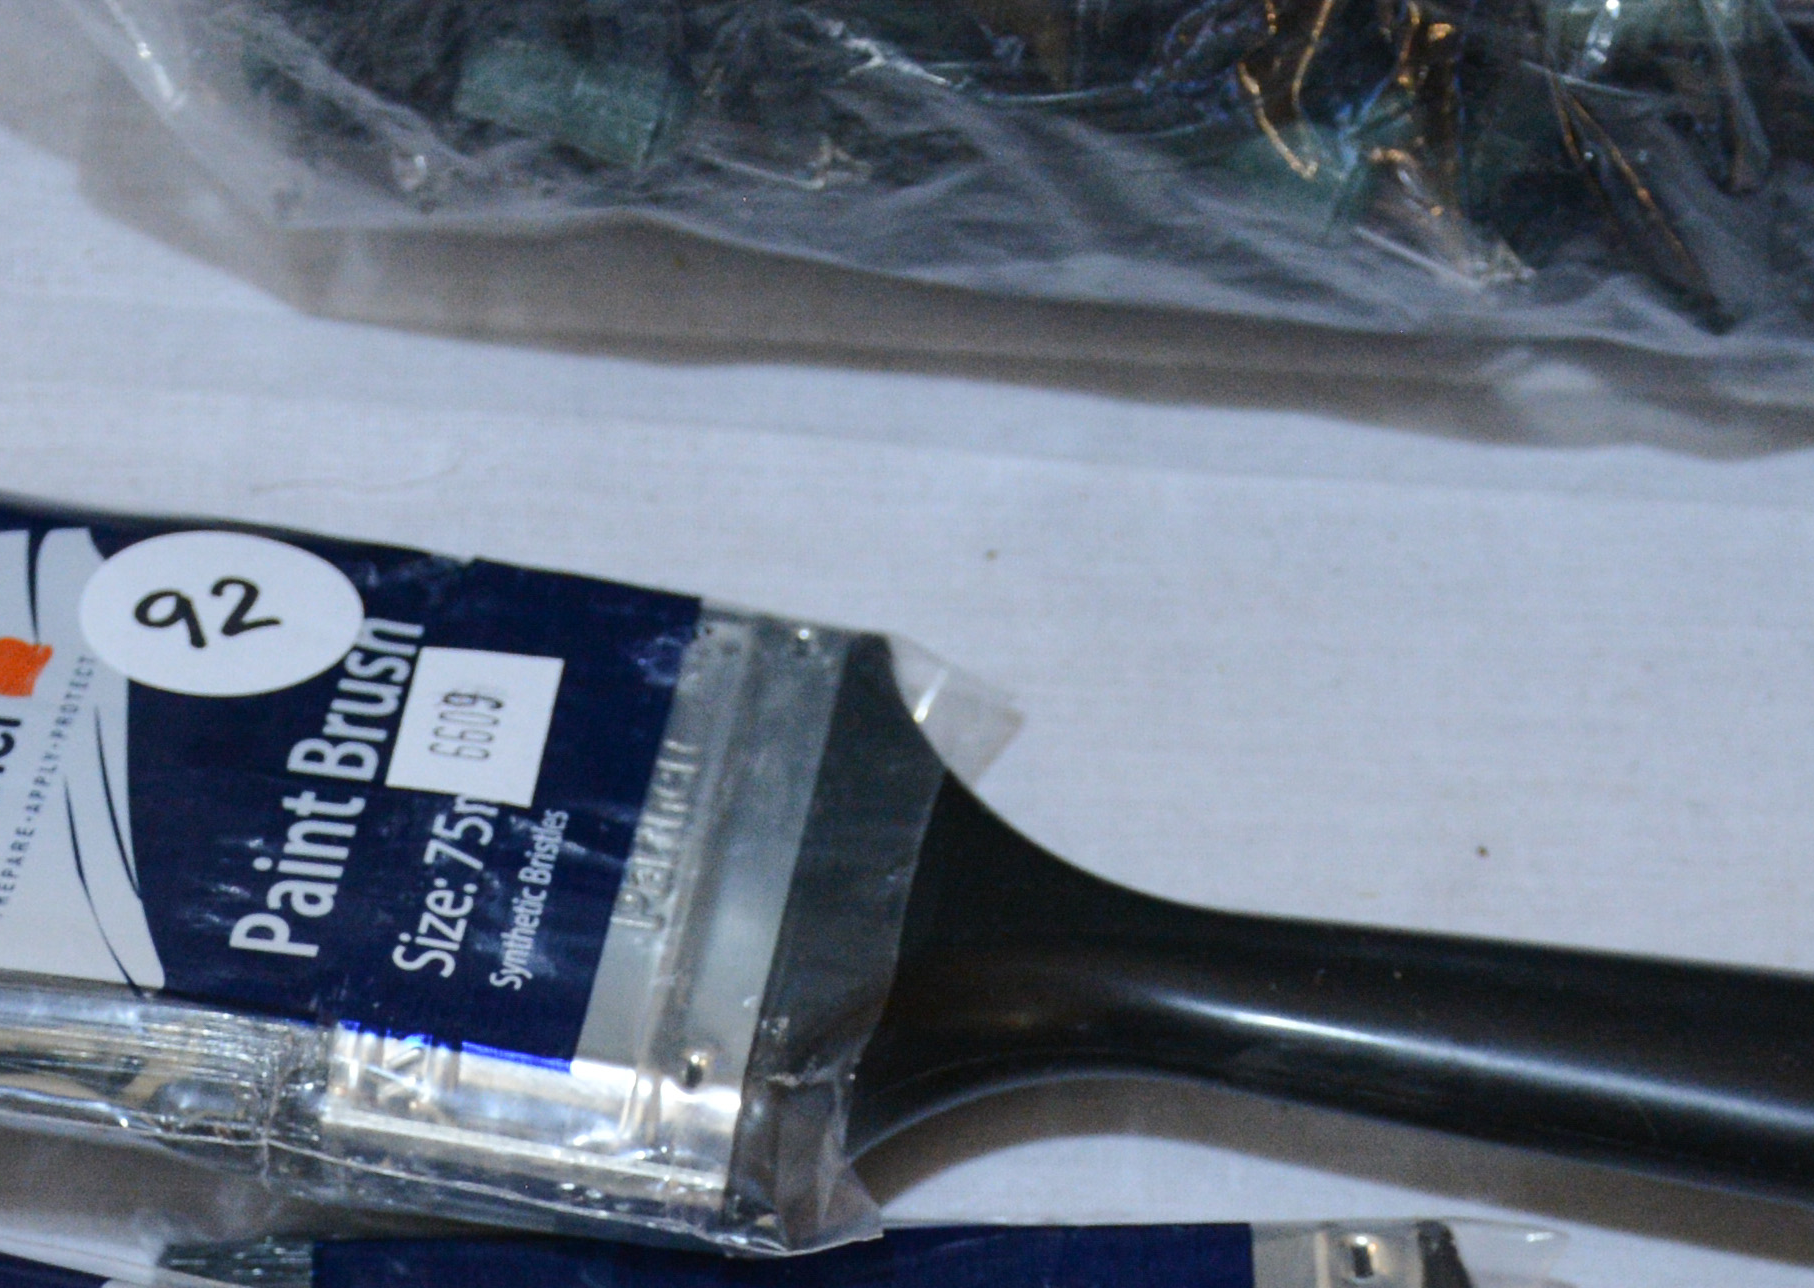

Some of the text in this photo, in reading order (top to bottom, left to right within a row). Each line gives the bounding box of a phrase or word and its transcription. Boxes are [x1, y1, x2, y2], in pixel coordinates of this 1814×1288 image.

[134, 576, 282, 649] 92
[230, 616, 424, 957] Paint Brush
[393, 879, 478, 978] Size:
[490, 809, 569, 991] Synthetic Bristles
